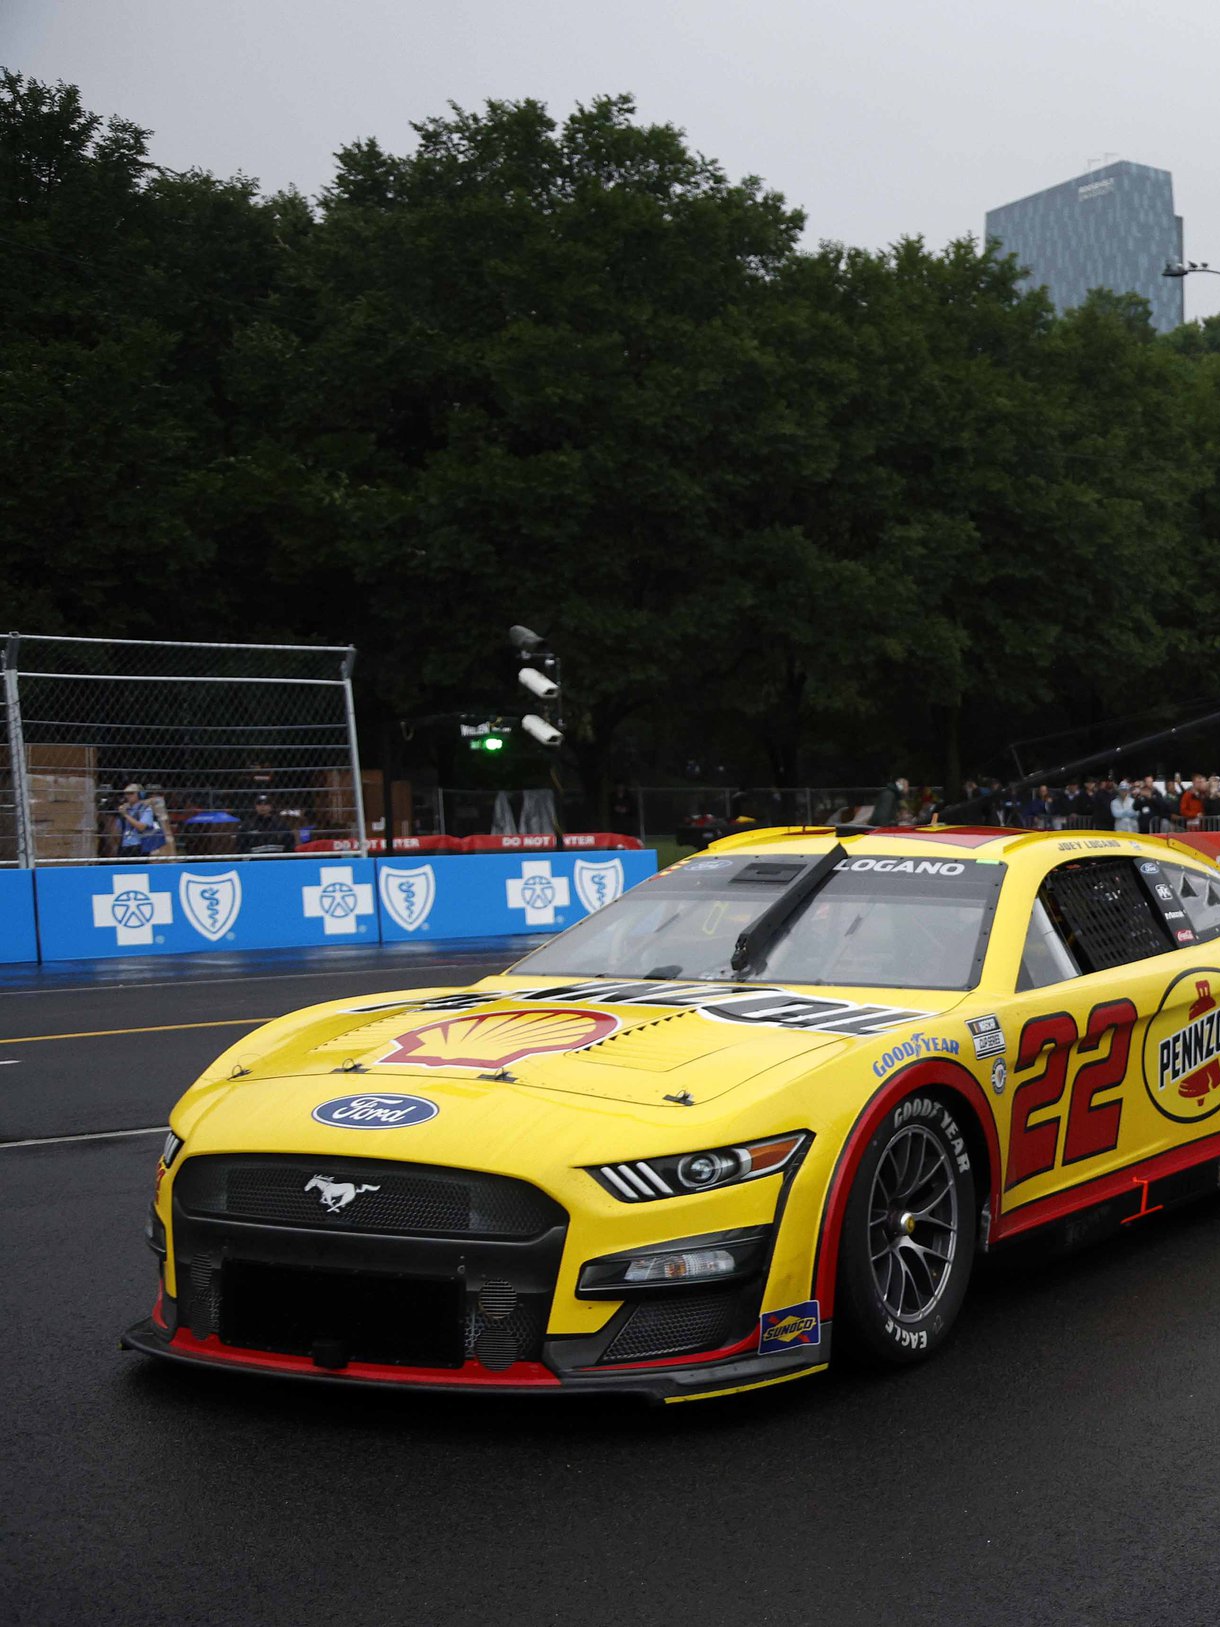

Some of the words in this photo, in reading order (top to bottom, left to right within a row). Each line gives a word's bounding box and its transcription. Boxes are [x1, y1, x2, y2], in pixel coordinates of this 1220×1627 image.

[1058, 841, 1082, 851] JOEY
[832, 858, 965, 876] LOGANO
[1003, 997, 1138, 1194] 22
[331, 1096, 417, 1123] Ford
[764, 1317, 816, 1342] SUNOCO
[885, 1316, 928, 1349] EAGLE
